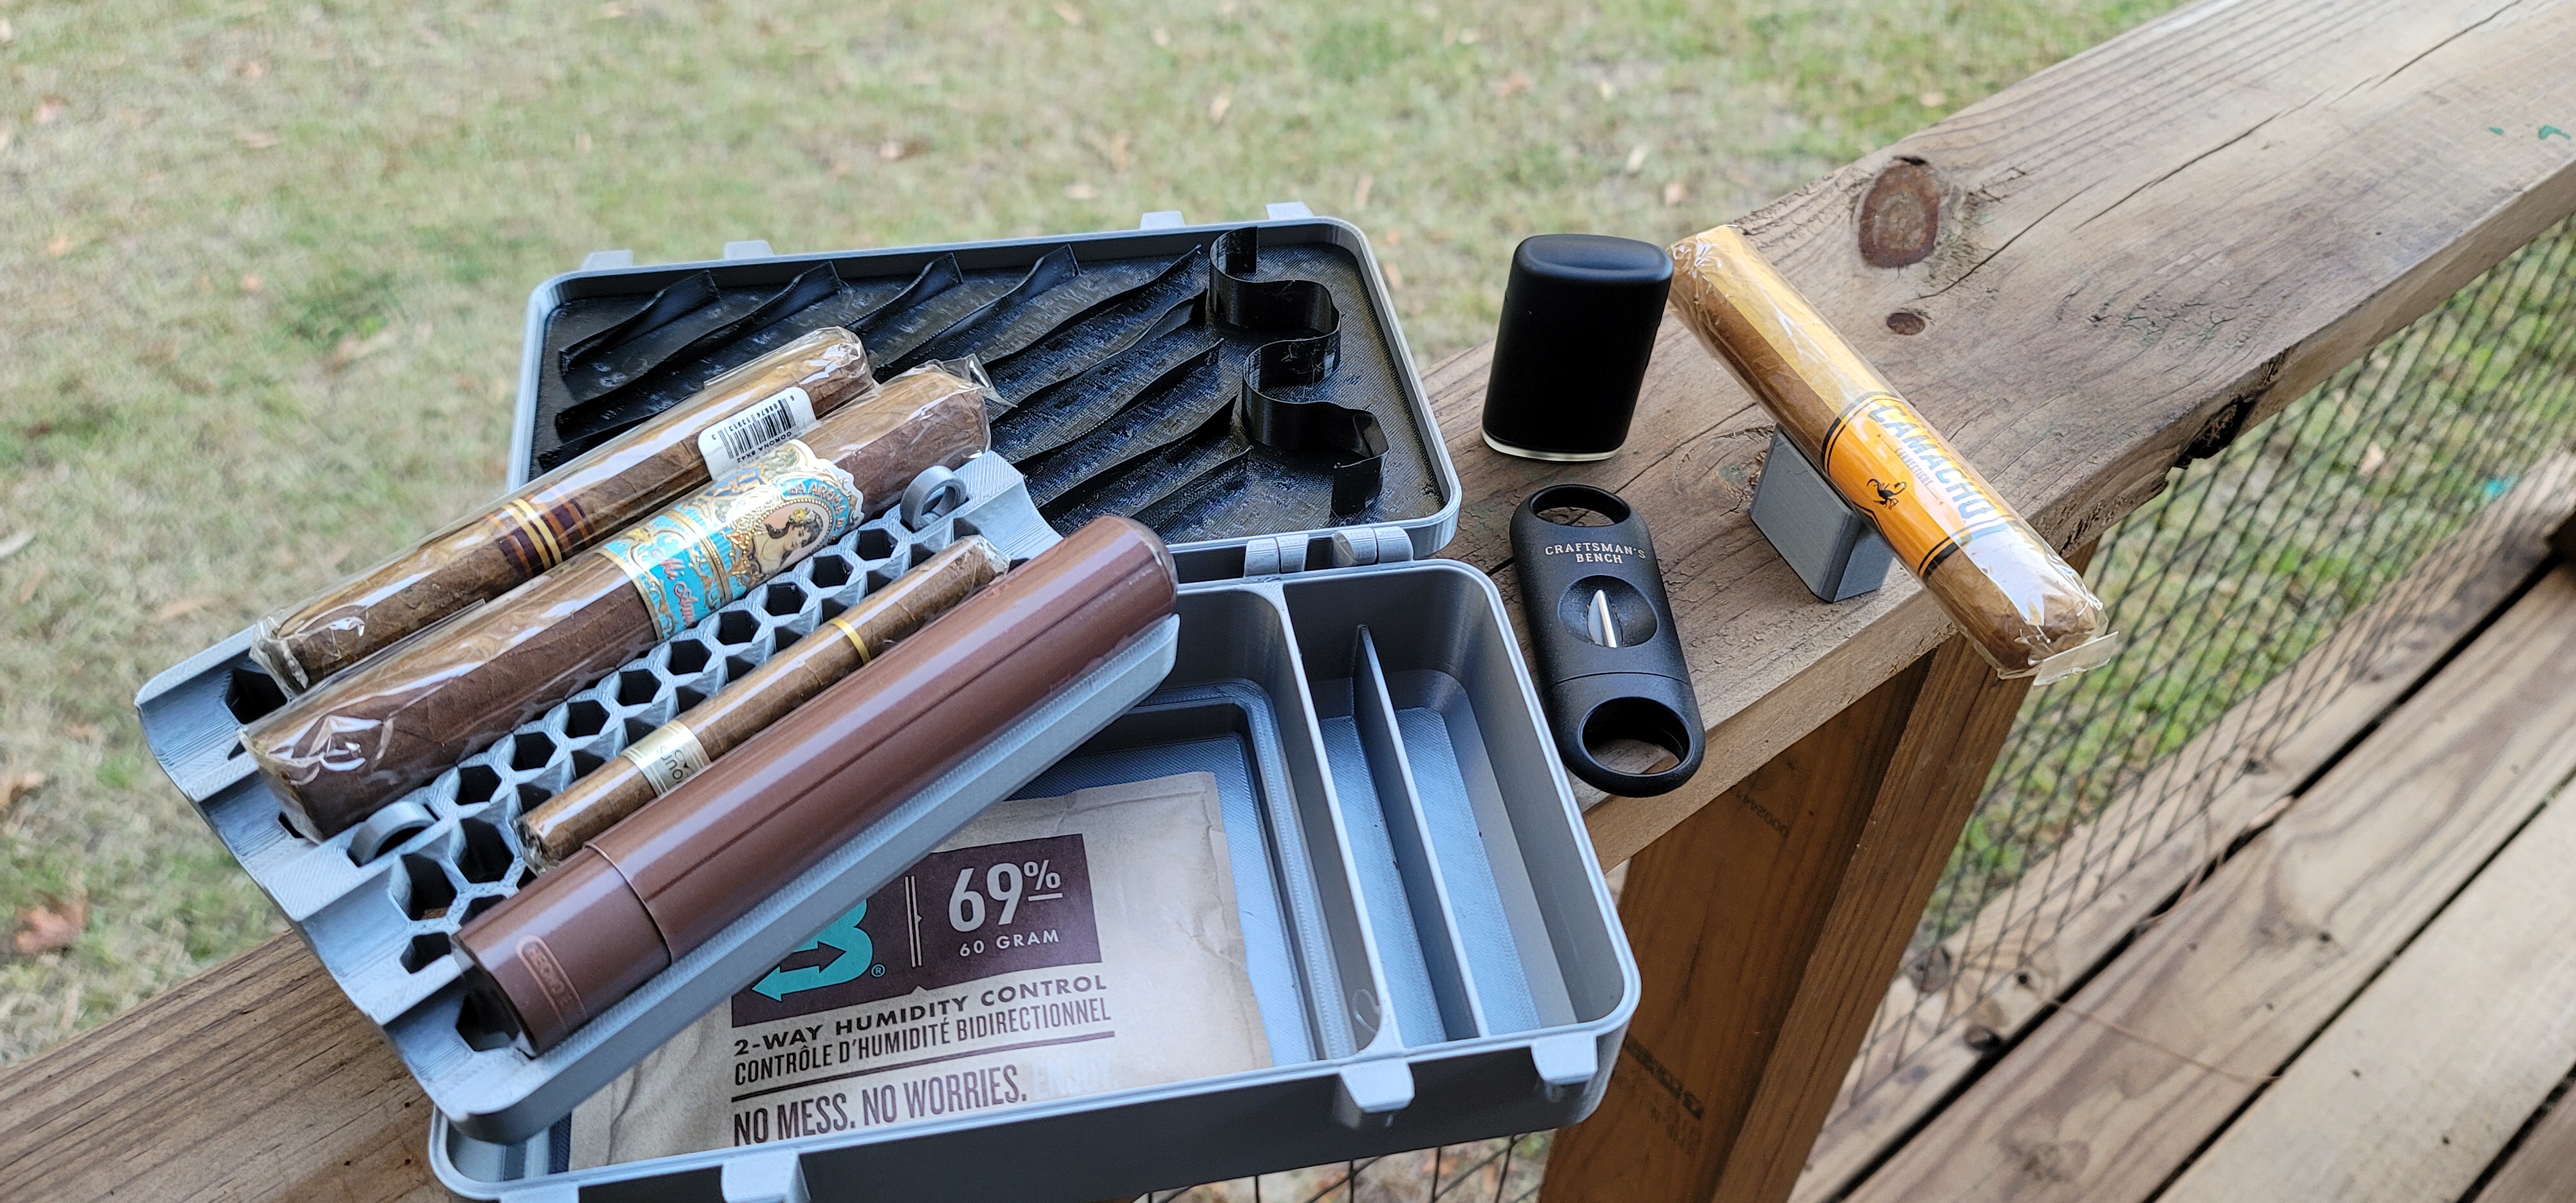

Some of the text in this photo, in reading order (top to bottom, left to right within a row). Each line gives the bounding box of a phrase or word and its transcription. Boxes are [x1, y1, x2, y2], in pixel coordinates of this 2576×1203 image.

[728, 417, 750, 431] 13913
[758, 431, 791, 451] CORONA
[1868, 404, 1998, 520] CAMACHO
[1893, 447, 1934, 486] CONNECTICUT
[808, 482, 847, 515] AROMA
[1545, 542, 1646, 560] CRAFTSMAN'S
[1576, 553, 1623, 564] BENCH
[947, 859, 1063, 933] 69%
[959, 929, 1060, 958] 60 GRAM
[734, 974, 1108, 1057] 2-WAY HUMIDITY CONTROL
[734, 996, 1112, 1086] CONTRÔLE D'HUMIDITÉ BIDIRECTIONNEL
[734, 1108, 769, 1146] NO
[777, 1092, 857, 1141] MESS.
[863, 1083, 898, 1126] NO
[903, 1065, 1027, 1118] WORRIES.
